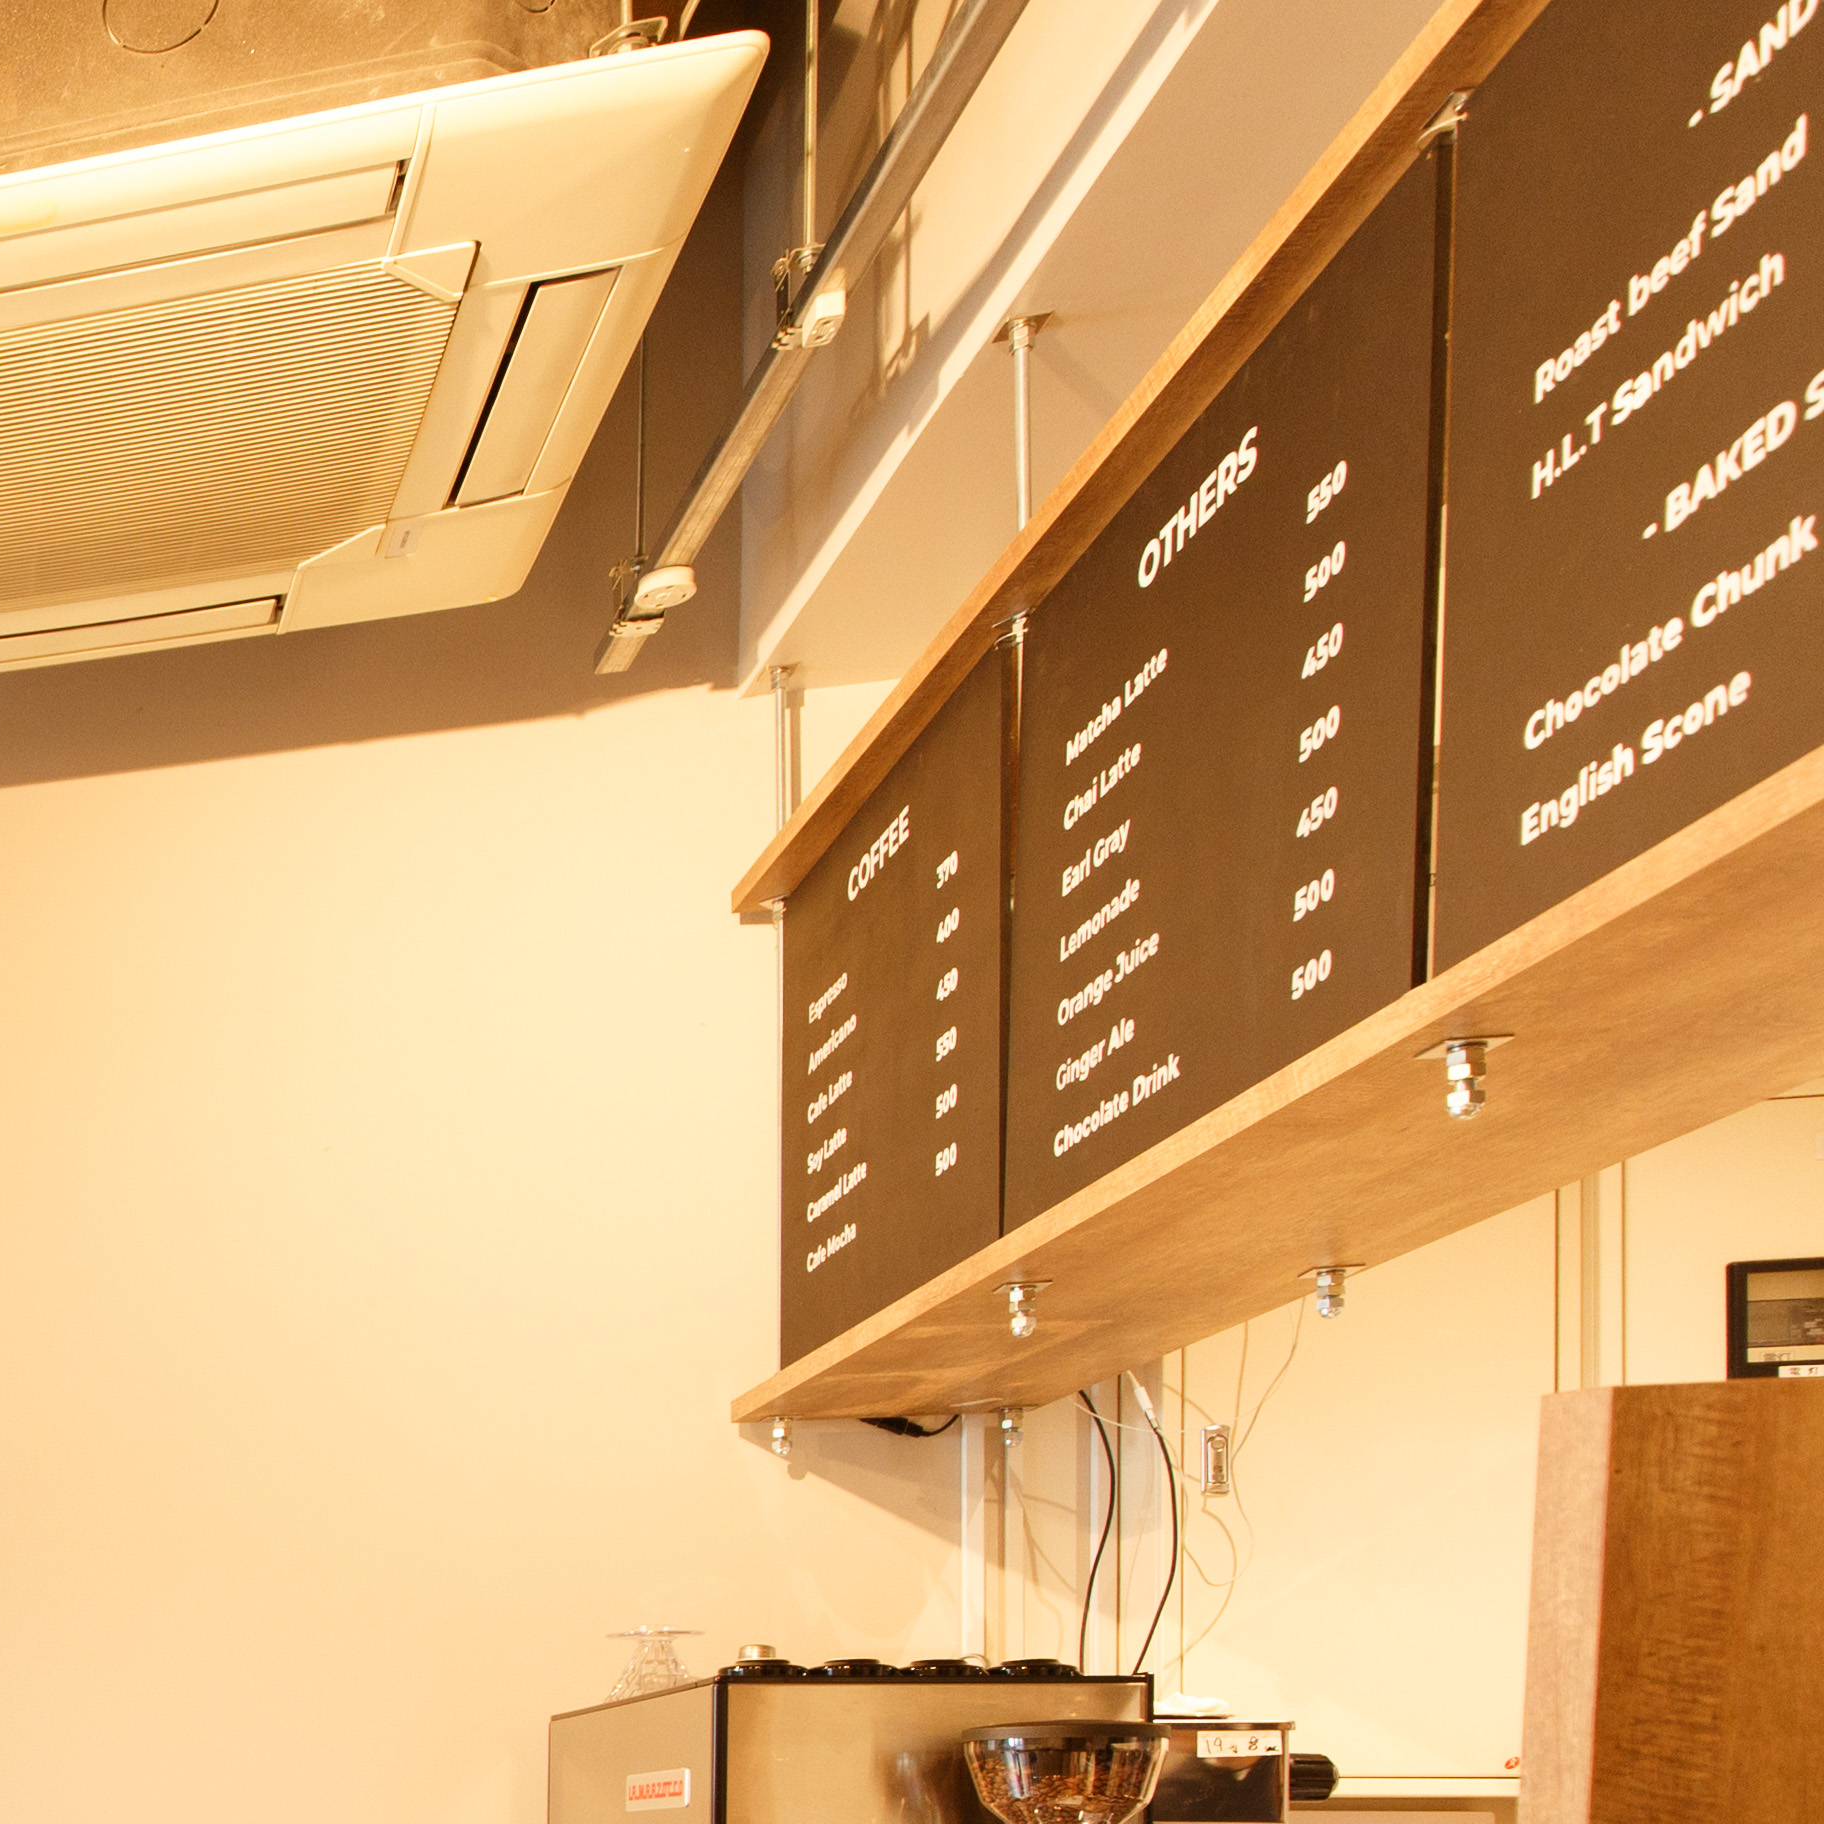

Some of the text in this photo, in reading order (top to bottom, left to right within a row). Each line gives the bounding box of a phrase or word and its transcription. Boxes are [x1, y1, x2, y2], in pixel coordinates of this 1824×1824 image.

[1535, 114, 1807, 404] Roast beef Sand
[1532, 254, 1784, 499] H.L.T Sandwich
[1665, 401, 1797, 532] BAKED
[1138, 426, 1258, 588] OTHERS
[1063, 541, 1346, 831] Chai Latte 500
[1066, 460, 1347, 766] Matcha Latte 550
[1524, 515, 1818, 750] Chocolate Chunk
[847, 805, 909, 901] COFFEE
[1060, 705, 1340, 962] Lemonade 500
[1062, 623, 1343, 897] Earl Gray 450
[1521, 671, 1751, 846] English Scone
[807, 907, 960, 1075] Americano 400
[808, 850, 958, 1024] Espresso 370
[1056, 868, 1335, 1091] Ginger Ale 500
[1057, 786, 1338, 1026] Orange Juice 450
[807, 967, 959, 1124] Cafe Latte 450
[807, 1026, 957, 1175] Soy Latte 550
[1053, 949, 1332, 1157] Chocolate Drink 500
[806, 1142, 957, 1273] Cafe Mocha 500
[807, 1083, 958, 1223] Caramel Latte 500
